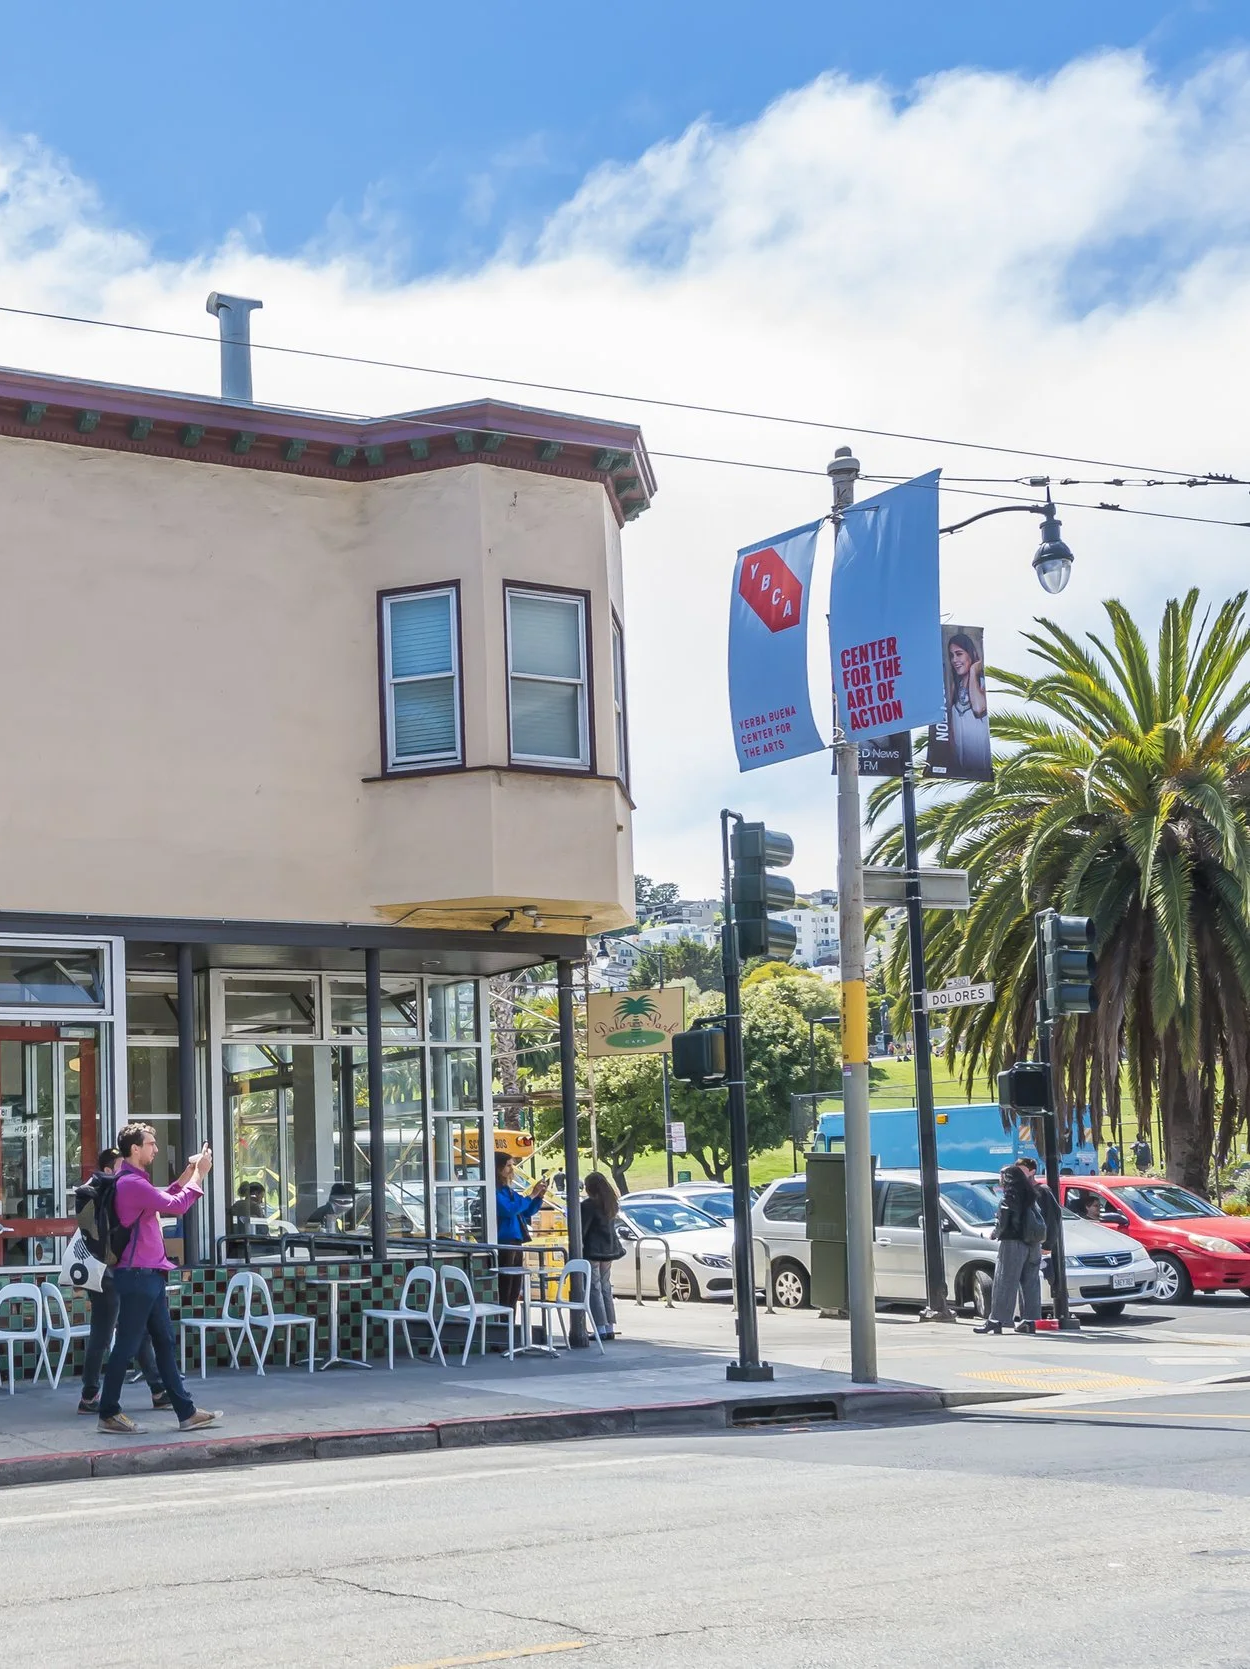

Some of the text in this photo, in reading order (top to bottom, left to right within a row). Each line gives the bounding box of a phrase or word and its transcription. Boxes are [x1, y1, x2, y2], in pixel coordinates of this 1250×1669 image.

[750, 562, 792, 618] YBCA
[840, 636, 897, 669] CENTER
[842, 656, 902, 690] FOR THE
[847, 679, 895, 710] ART OF
[739, 705, 797, 730] YERBA BUENA
[850, 699, 903, 731] ACTION
[741, 722, 792, 745] CENTER FOR
[744, 739, 785, 759] THE ARTS
[872, 748, 900, 759] News
[863, 760, 878, 771] FM
[932, 988, 985, 1005] DOLORES
[495, 1139, 508, 1149] BUS
